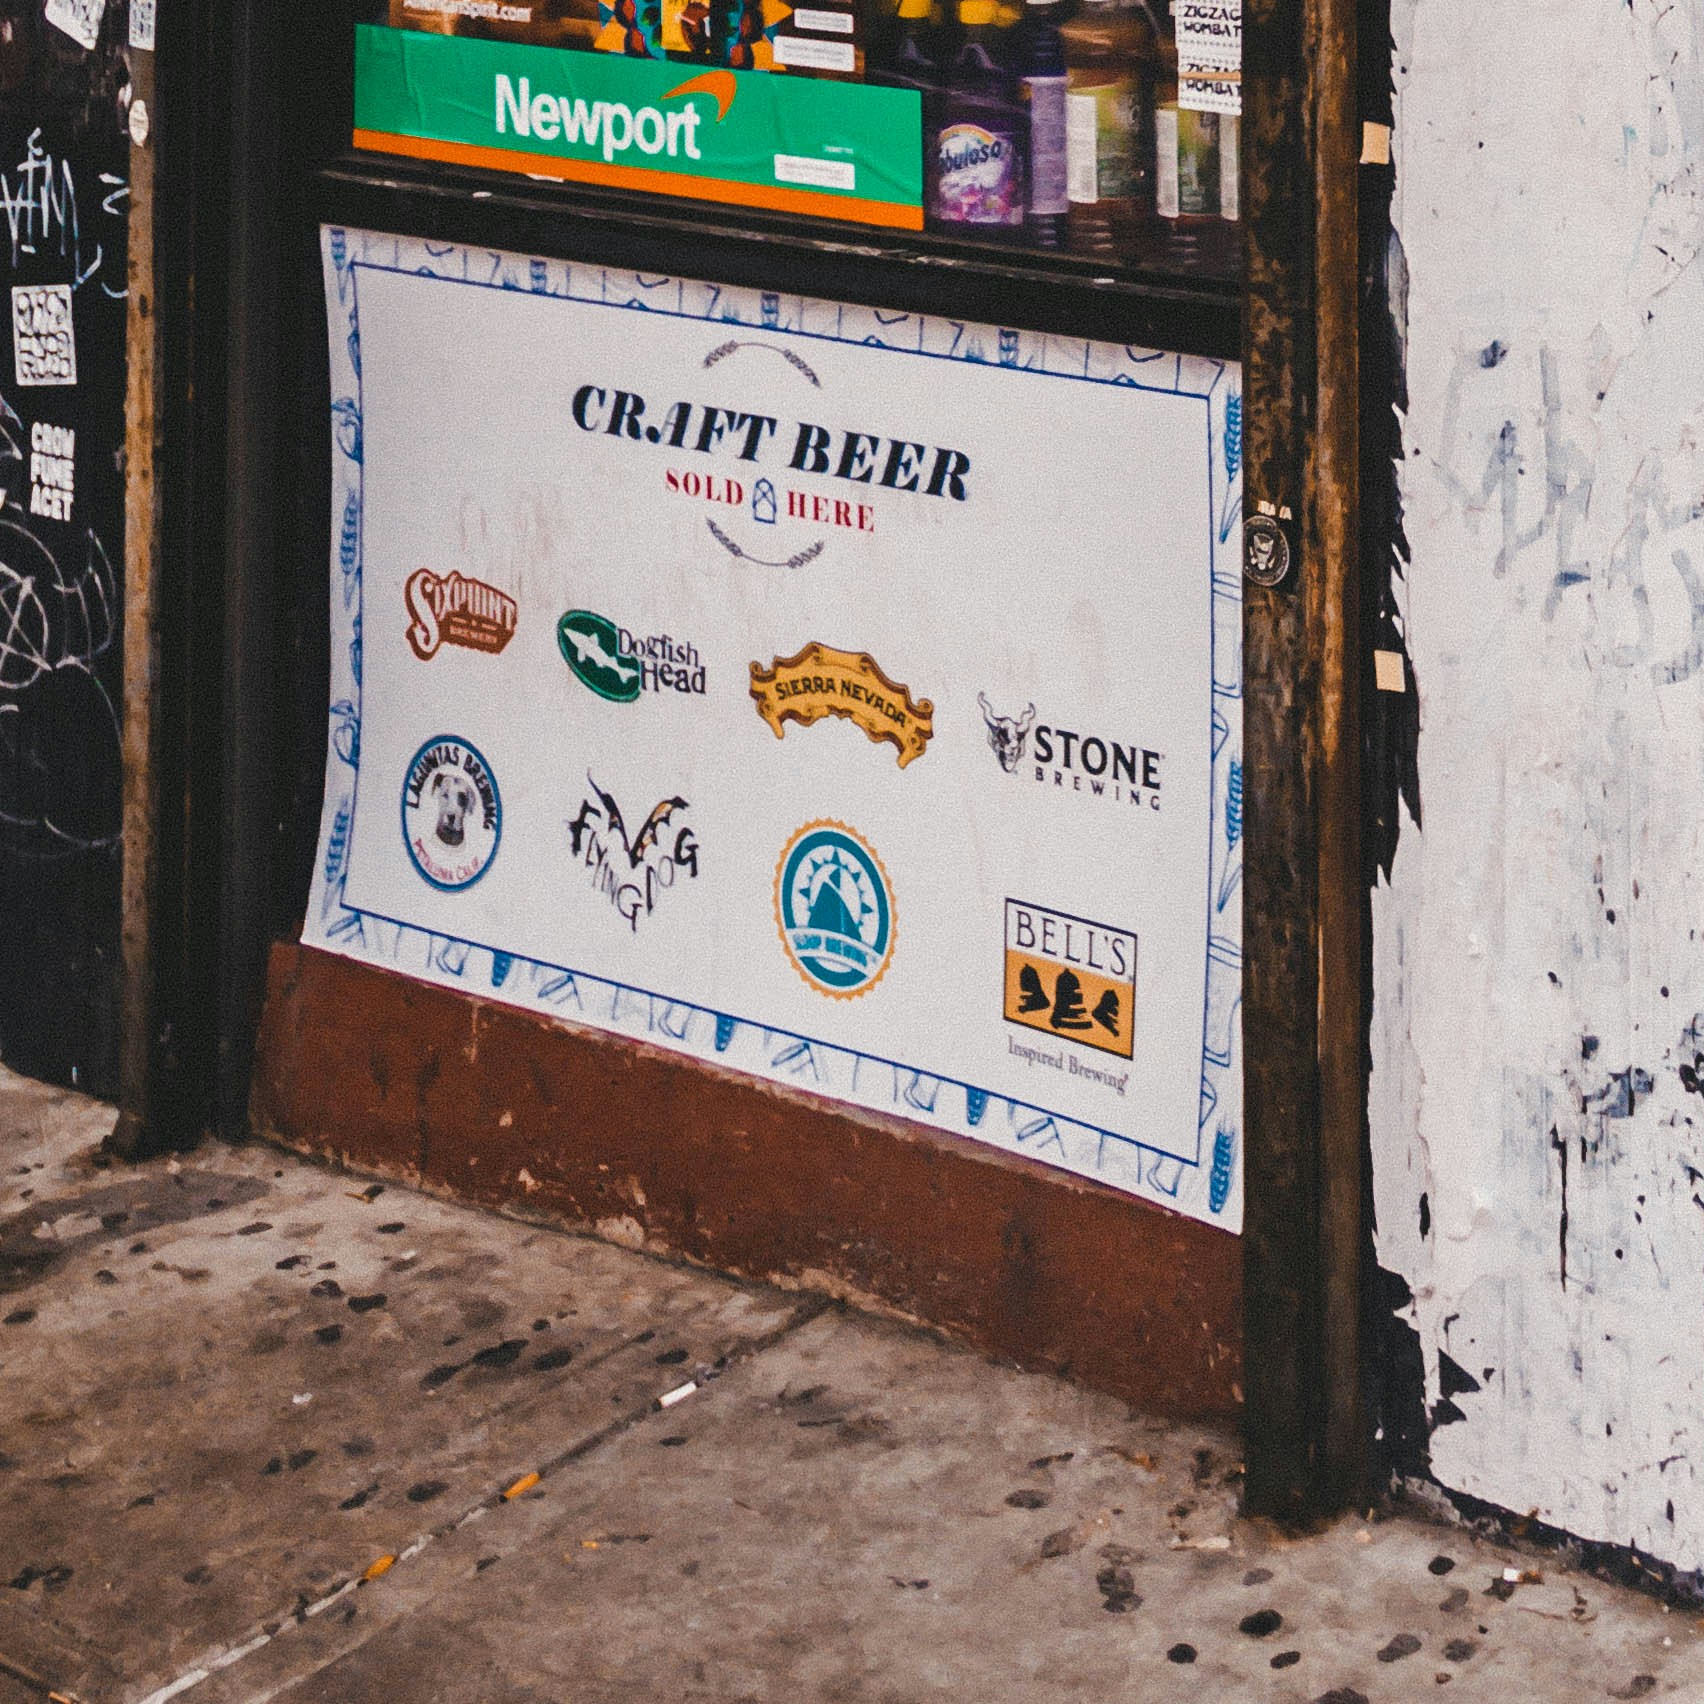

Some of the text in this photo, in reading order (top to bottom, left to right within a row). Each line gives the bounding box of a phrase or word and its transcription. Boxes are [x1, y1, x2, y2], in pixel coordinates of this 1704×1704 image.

[494, 74, 702, 161] Newport
[572, 384, 971, 502] CRAFT BEER
[665, 467, 876, 534] SOLD HERE
[617, 628, 699, 668] Dogfish
[640, 660, 706, 695] Head
[775, 674, 907, 728] SIERRA NEVADA
[405, 745, 497, 831] LAGUNITAS BREWING
[1034, 725, 1161, 791] STONE
[1034, 766, 1161, 811] BREWING
[1016, 910, 1126, 976] BELL'S
[1007, 1035, 1129, 1097] Inspired Brewing
